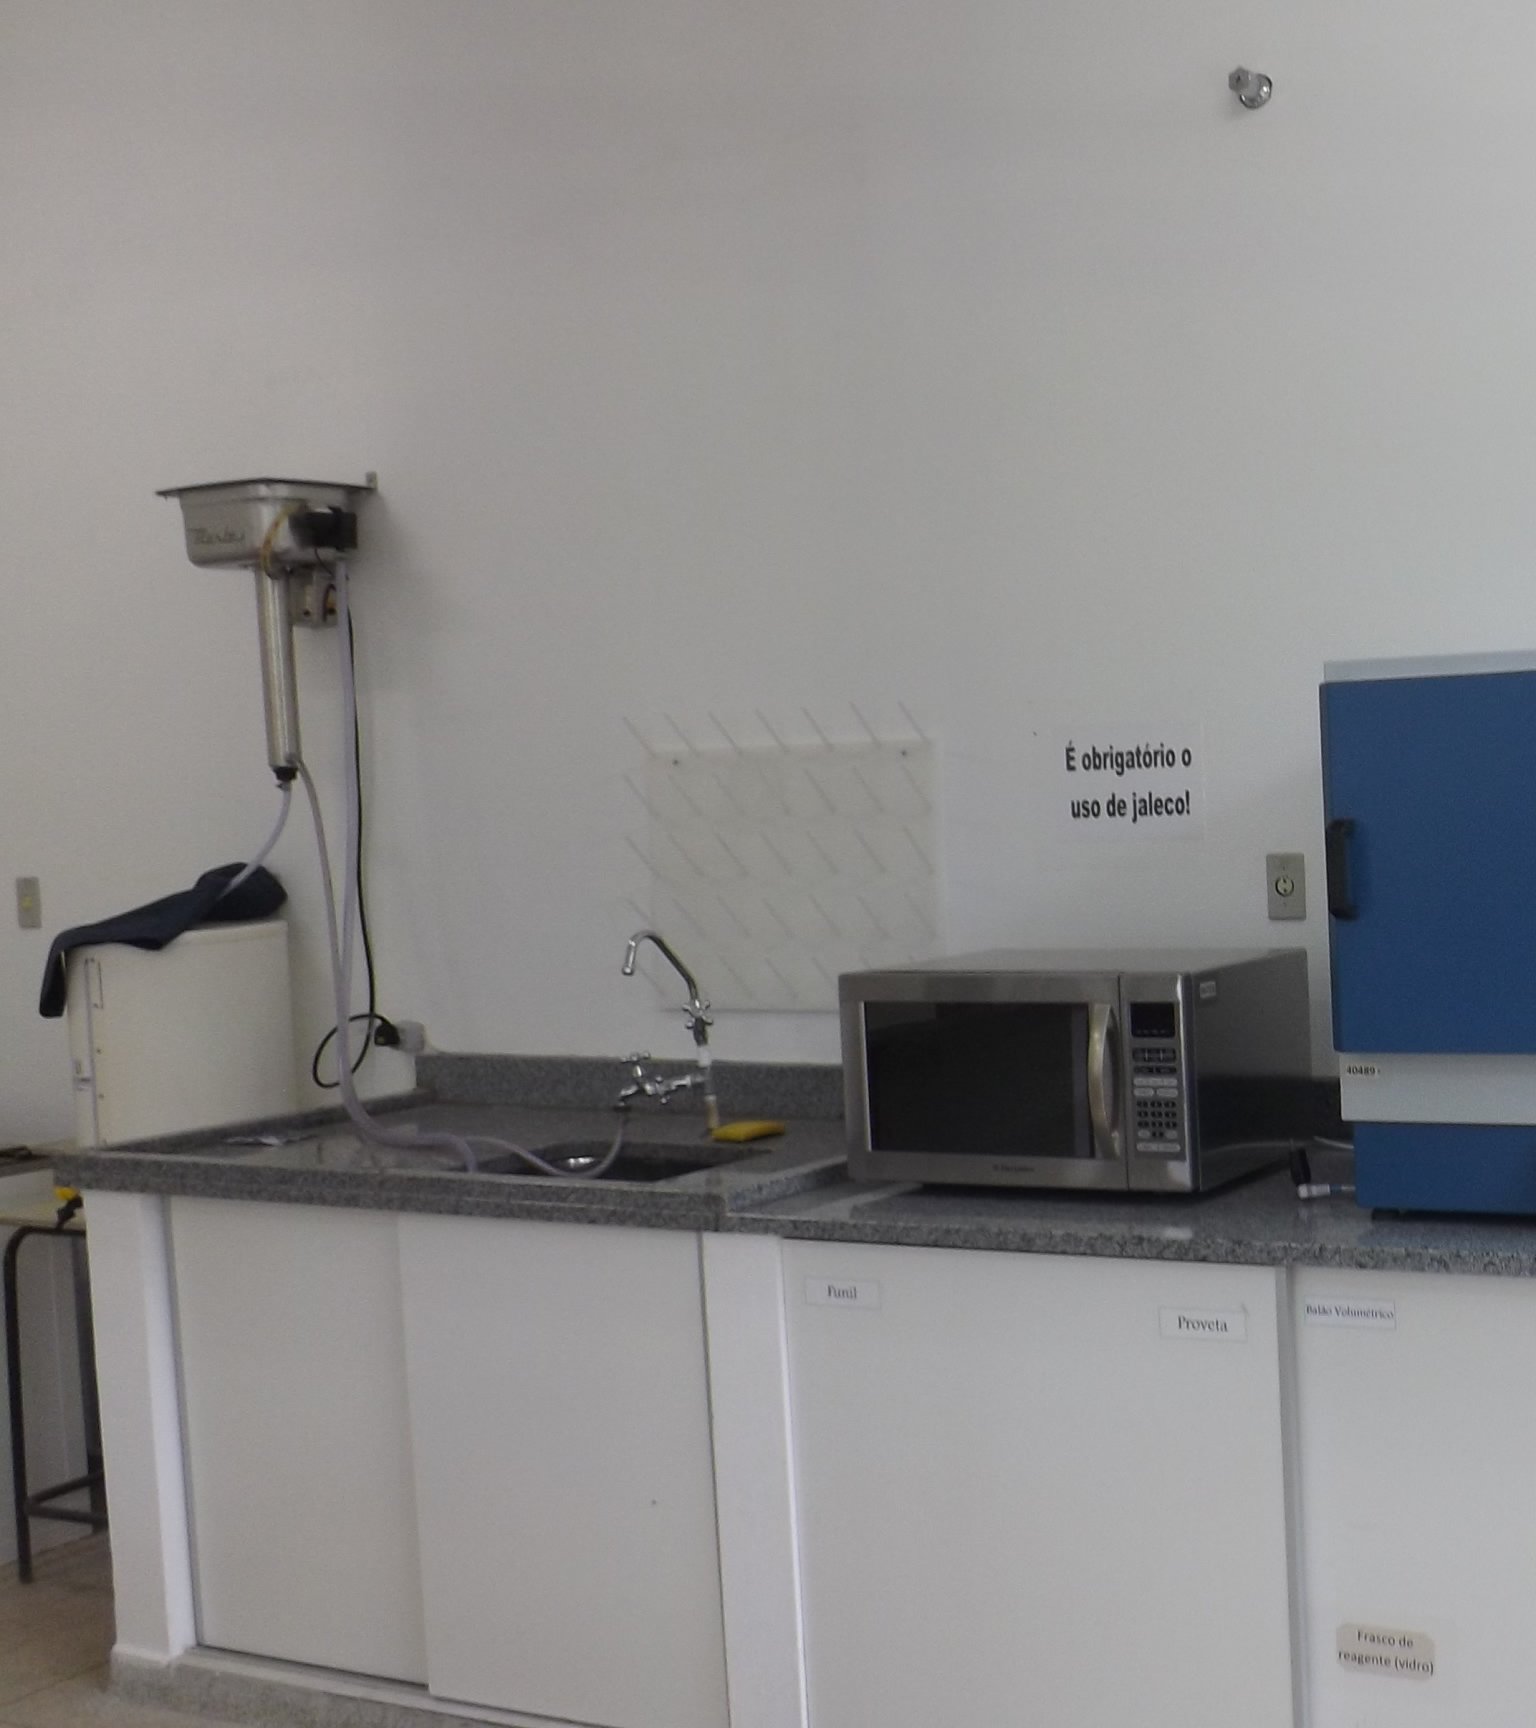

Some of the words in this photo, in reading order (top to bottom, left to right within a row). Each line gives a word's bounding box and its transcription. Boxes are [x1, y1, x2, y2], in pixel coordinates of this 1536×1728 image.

[1064, 740, 1077, 771] É
[1081, 742, 1176, 777] obrigatório
[1181, 748, 1192, 767] o
[1070, 799, 1101, 819] uso
[1106, 792, 1127, 817] de
[1131, 789, 1190, 824] jaleco!
[827, 1284, 857, 1299] Funil
[1178, 1315, 1228, 1333] Proveta
[1357, 1629, 1396, 1646] Frasco
[1399, 1635, 1414, 1648] de
[1338, 1651, 1391, 1667] reagente
[1394, 1656, 1434, 1676] (vidro)
